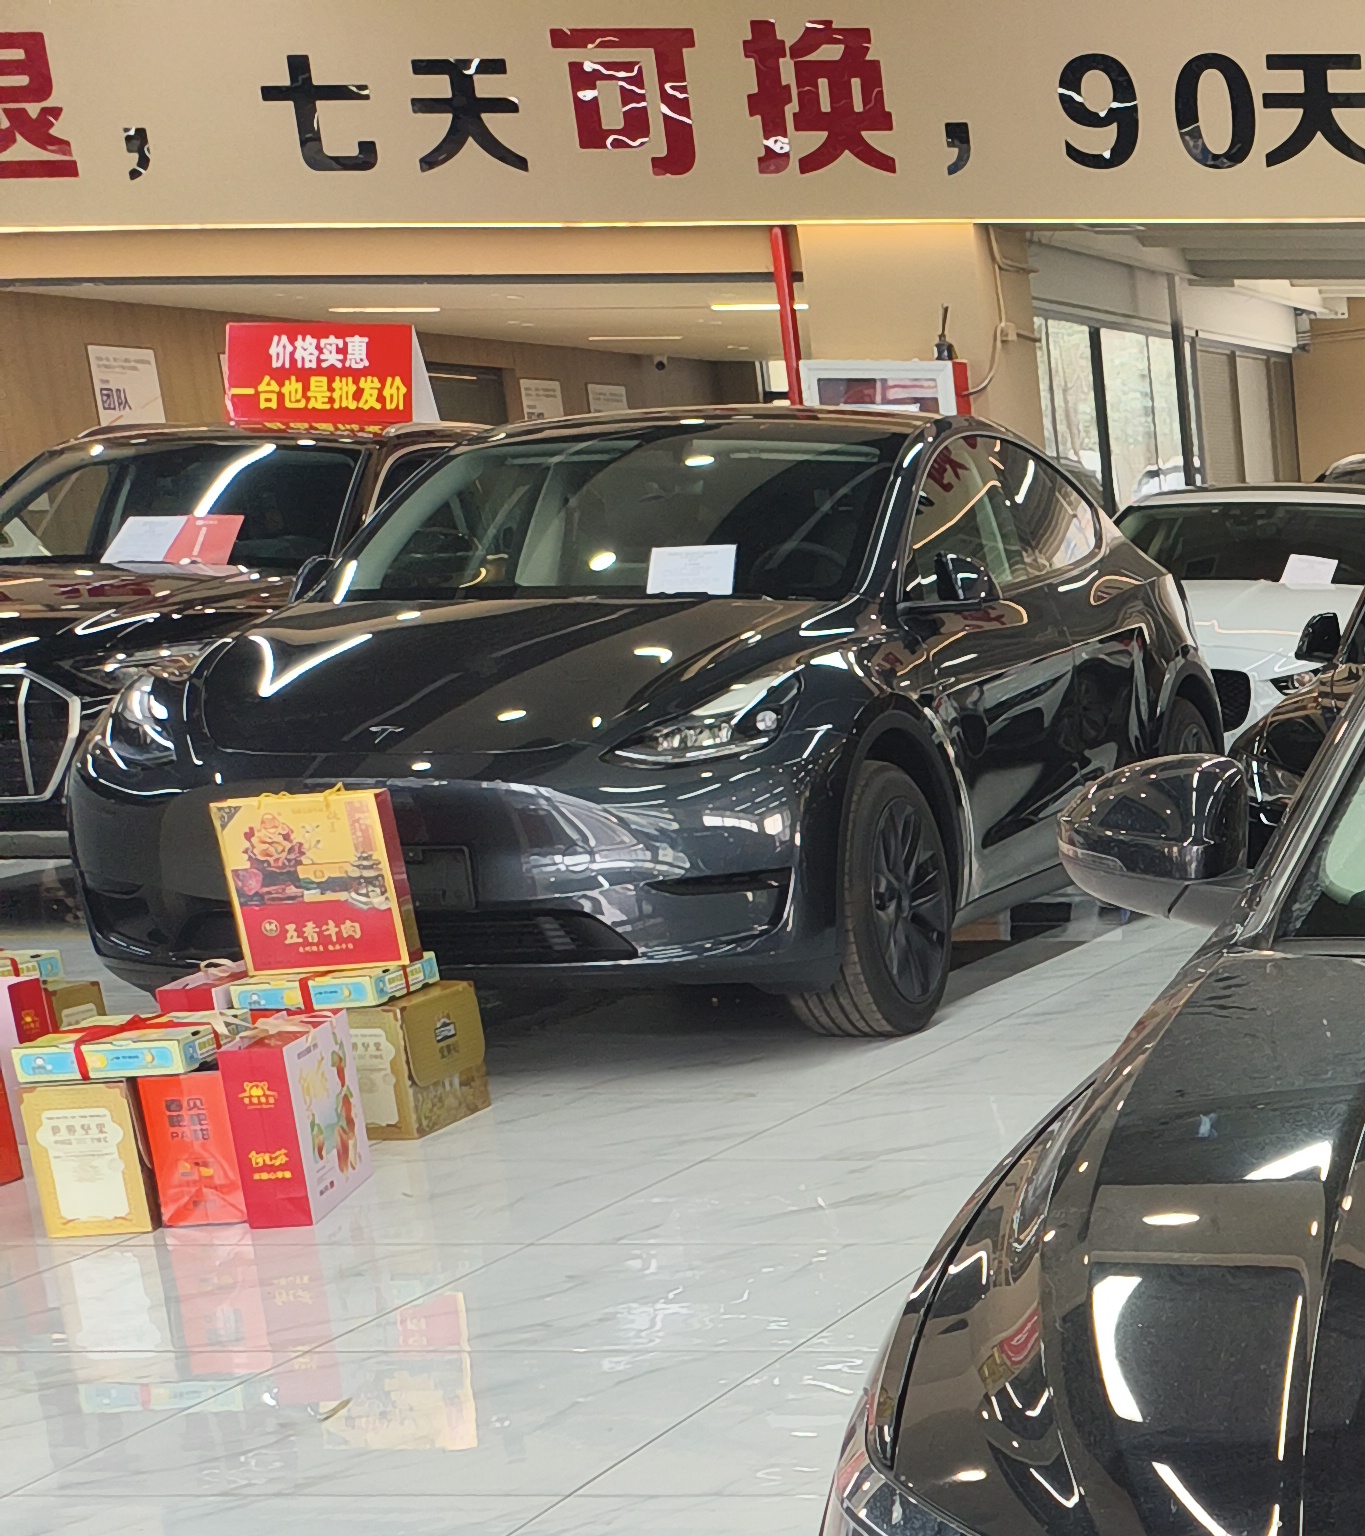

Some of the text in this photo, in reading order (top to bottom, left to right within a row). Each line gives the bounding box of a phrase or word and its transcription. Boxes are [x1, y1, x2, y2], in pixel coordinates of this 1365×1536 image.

[268, 334, 370, 369] 价格实惠
[99, 387, 132, 412] 团队
[230, 375, 408, 411] 一台也是批发价
[284, 919, 362, 945] 五香牛肉
